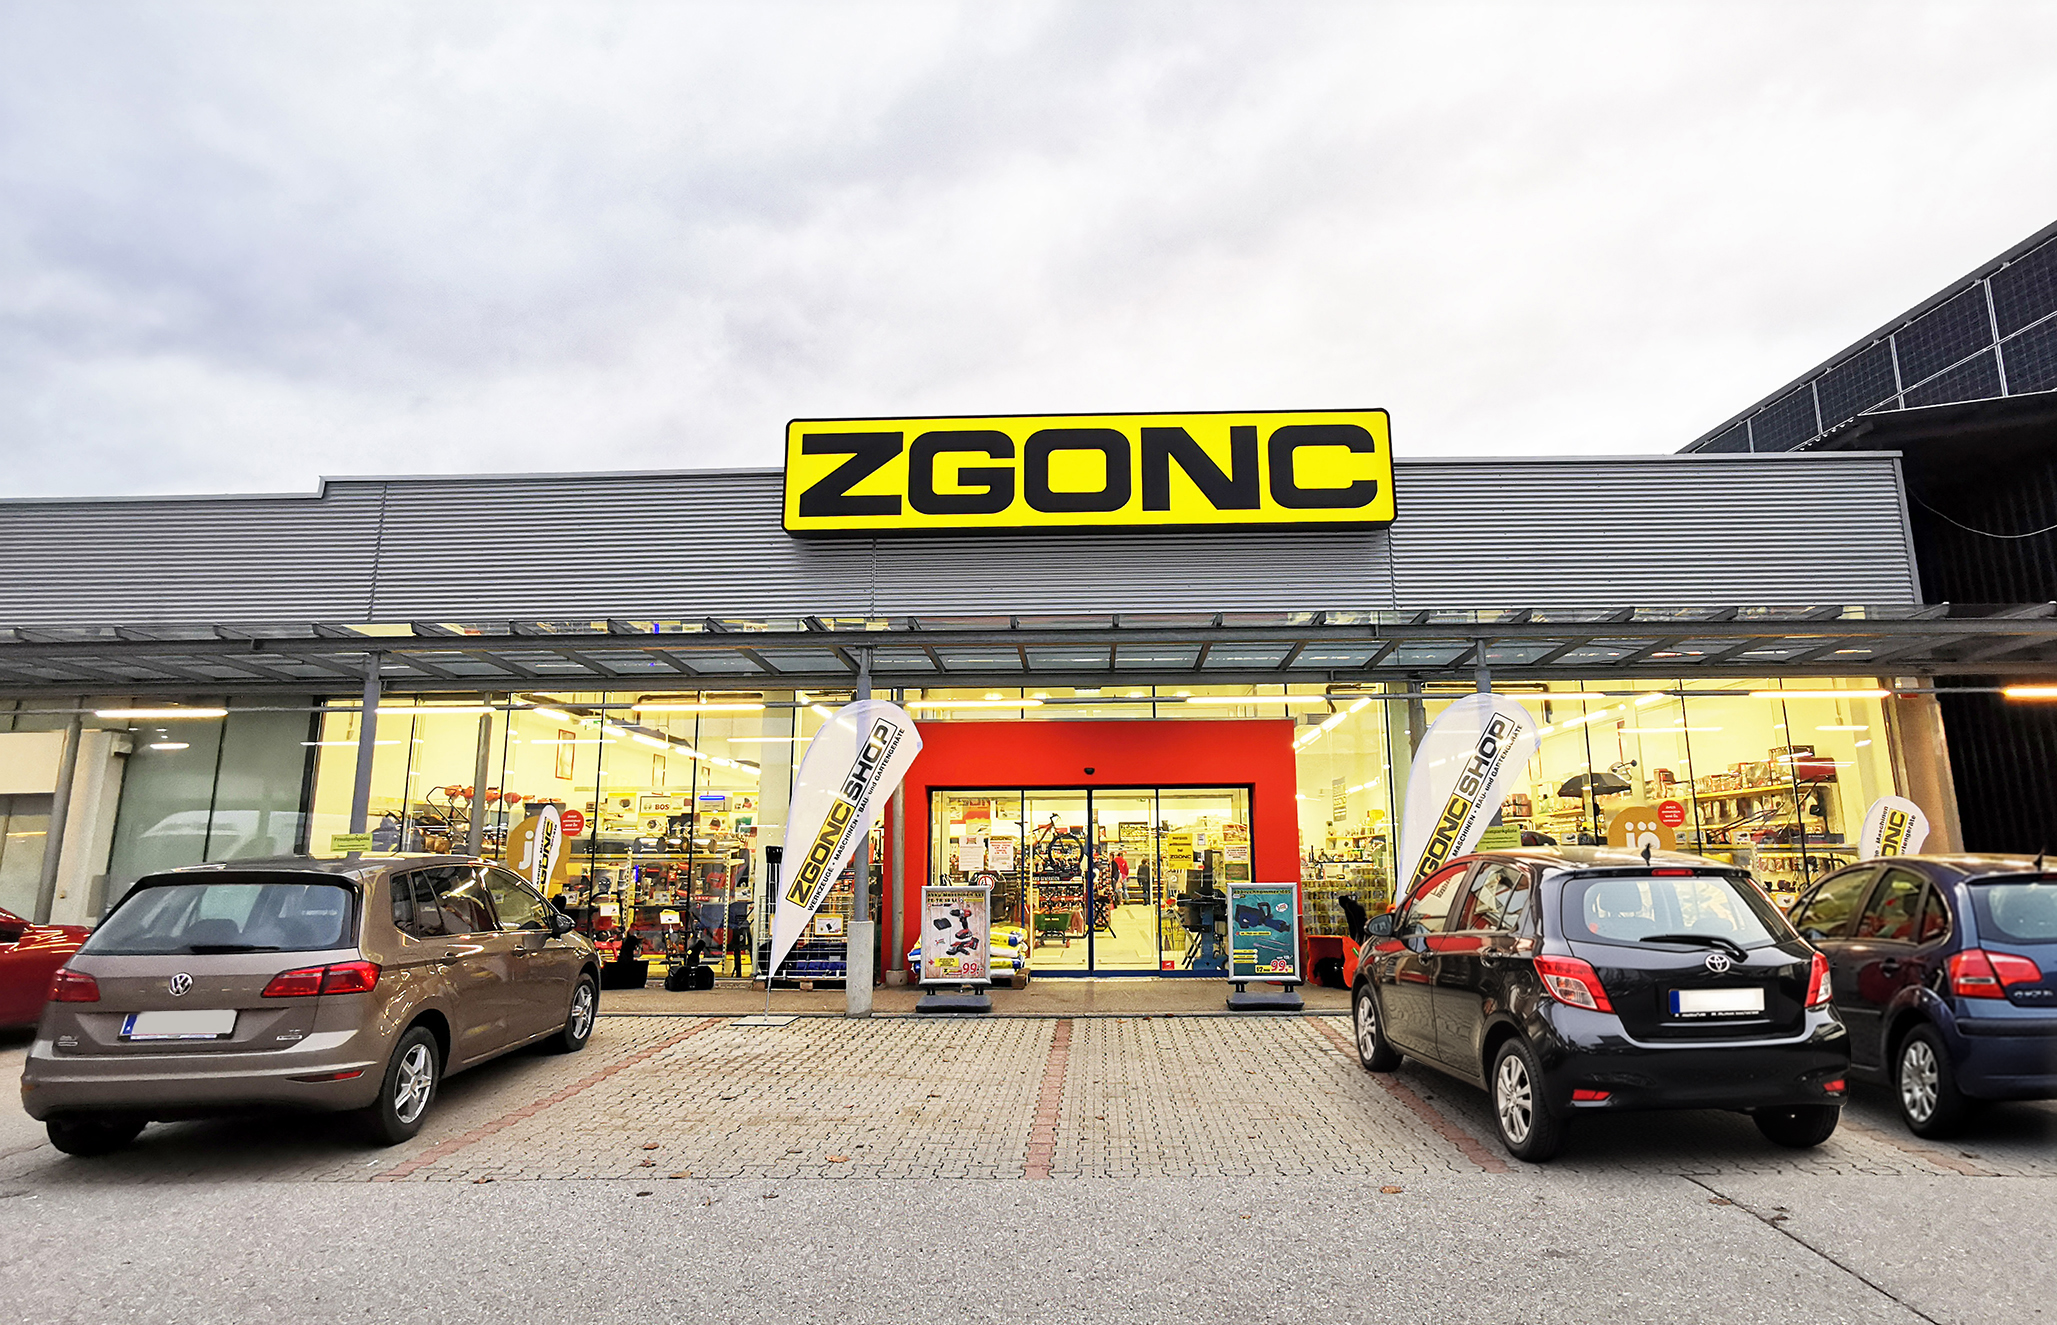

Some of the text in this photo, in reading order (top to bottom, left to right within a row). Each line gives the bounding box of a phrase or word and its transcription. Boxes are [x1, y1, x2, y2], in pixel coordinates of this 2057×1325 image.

[800, 424, 1378, 517] ZGONC
[790, 724, 888, 904] ZGONC SHOP
[807, 867, 835, 911] WERKZEUGE
[834, 819, 859, 861] MASCHINEN
[868, 781, 877, 795] und
[874, 728, 905, 781] GARTENGERÄTE
[1409, 798, 1467, 893] GONC
[1459, 719, 1505, 797] SHOP
[1452, 814, 1476, 857] MASCHINEN
[1485, 778, 1494, 791] und
